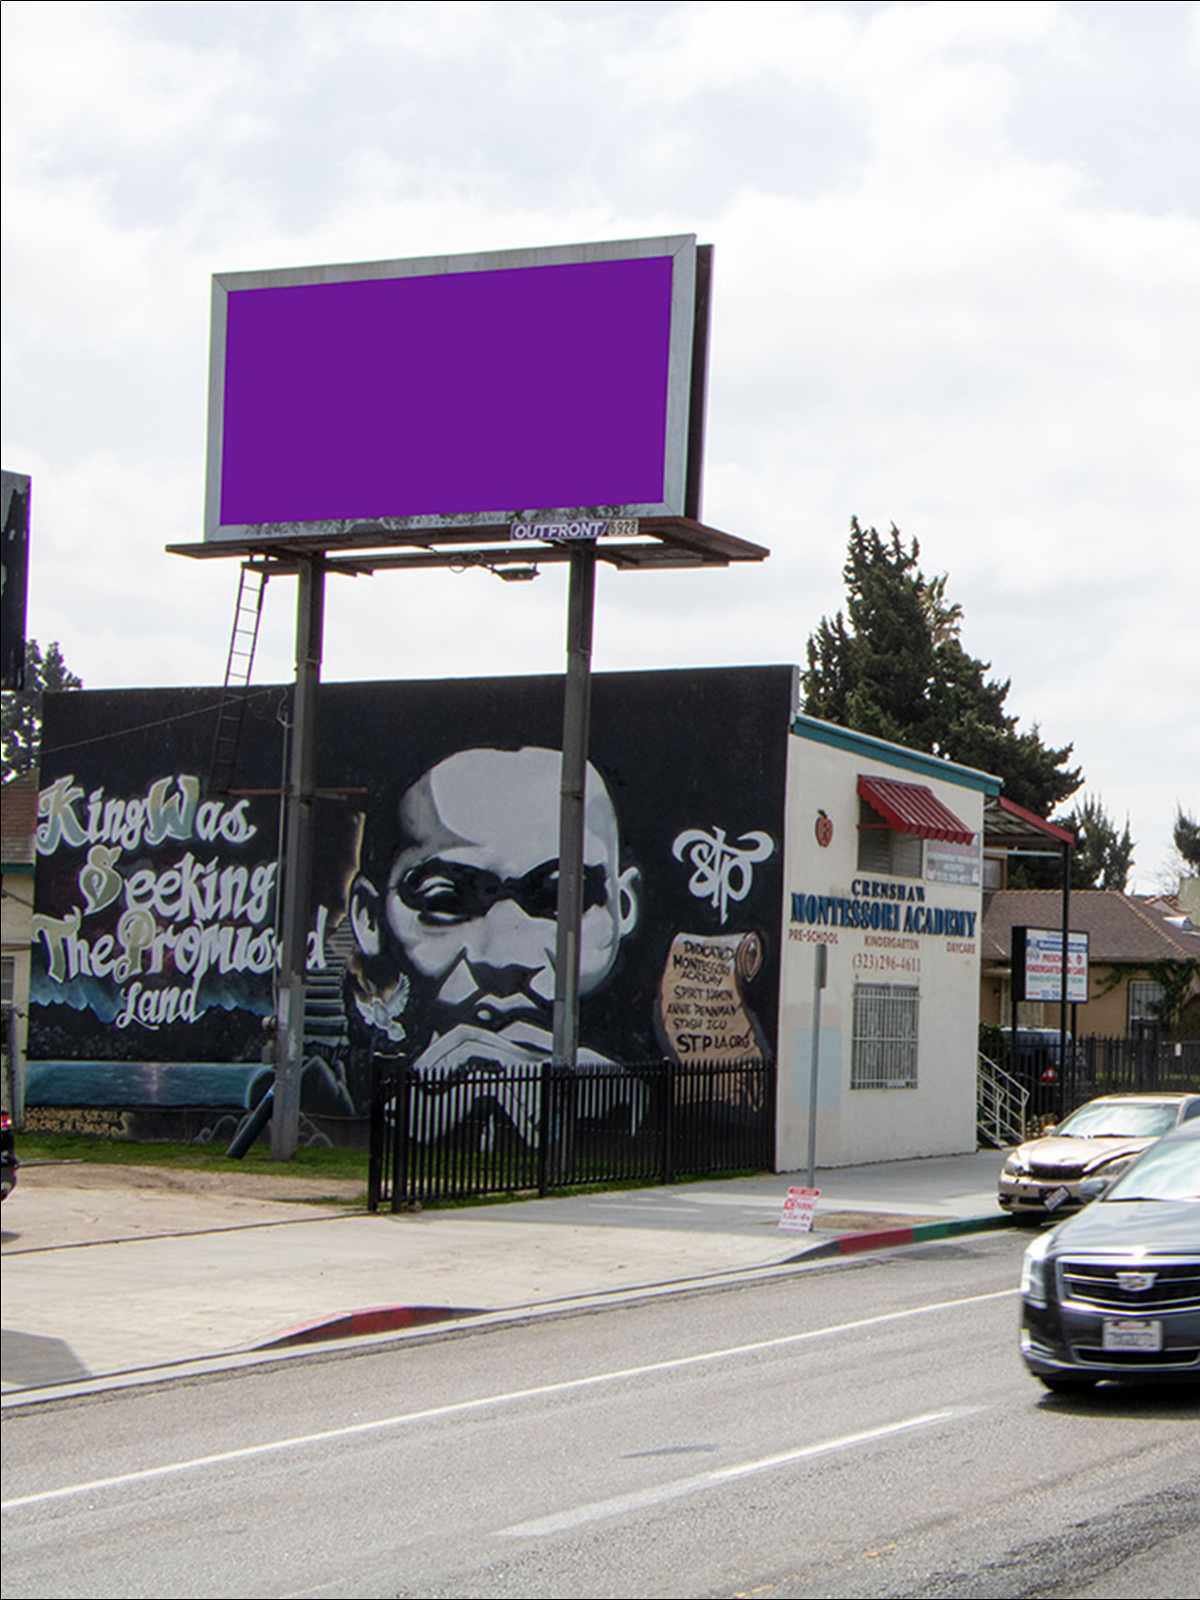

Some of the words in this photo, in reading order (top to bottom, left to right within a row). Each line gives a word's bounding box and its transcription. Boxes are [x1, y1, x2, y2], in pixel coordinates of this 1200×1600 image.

[36, 774, 146, 855] King
[144, 774, 257, 846] Was
[80, 845, 278, 924] Seeking
[851, 879, 925, 902] CRENSHAW
[788, 929, 839, 945] PRE-SCHOOL
[790, 893, 900, 931] MONTESSORI
[903, 905, 977, 938] ACADEMY
[864, 936, 920, 950] KINDERGARTEN
[116, 974, 205, 1031] Land
